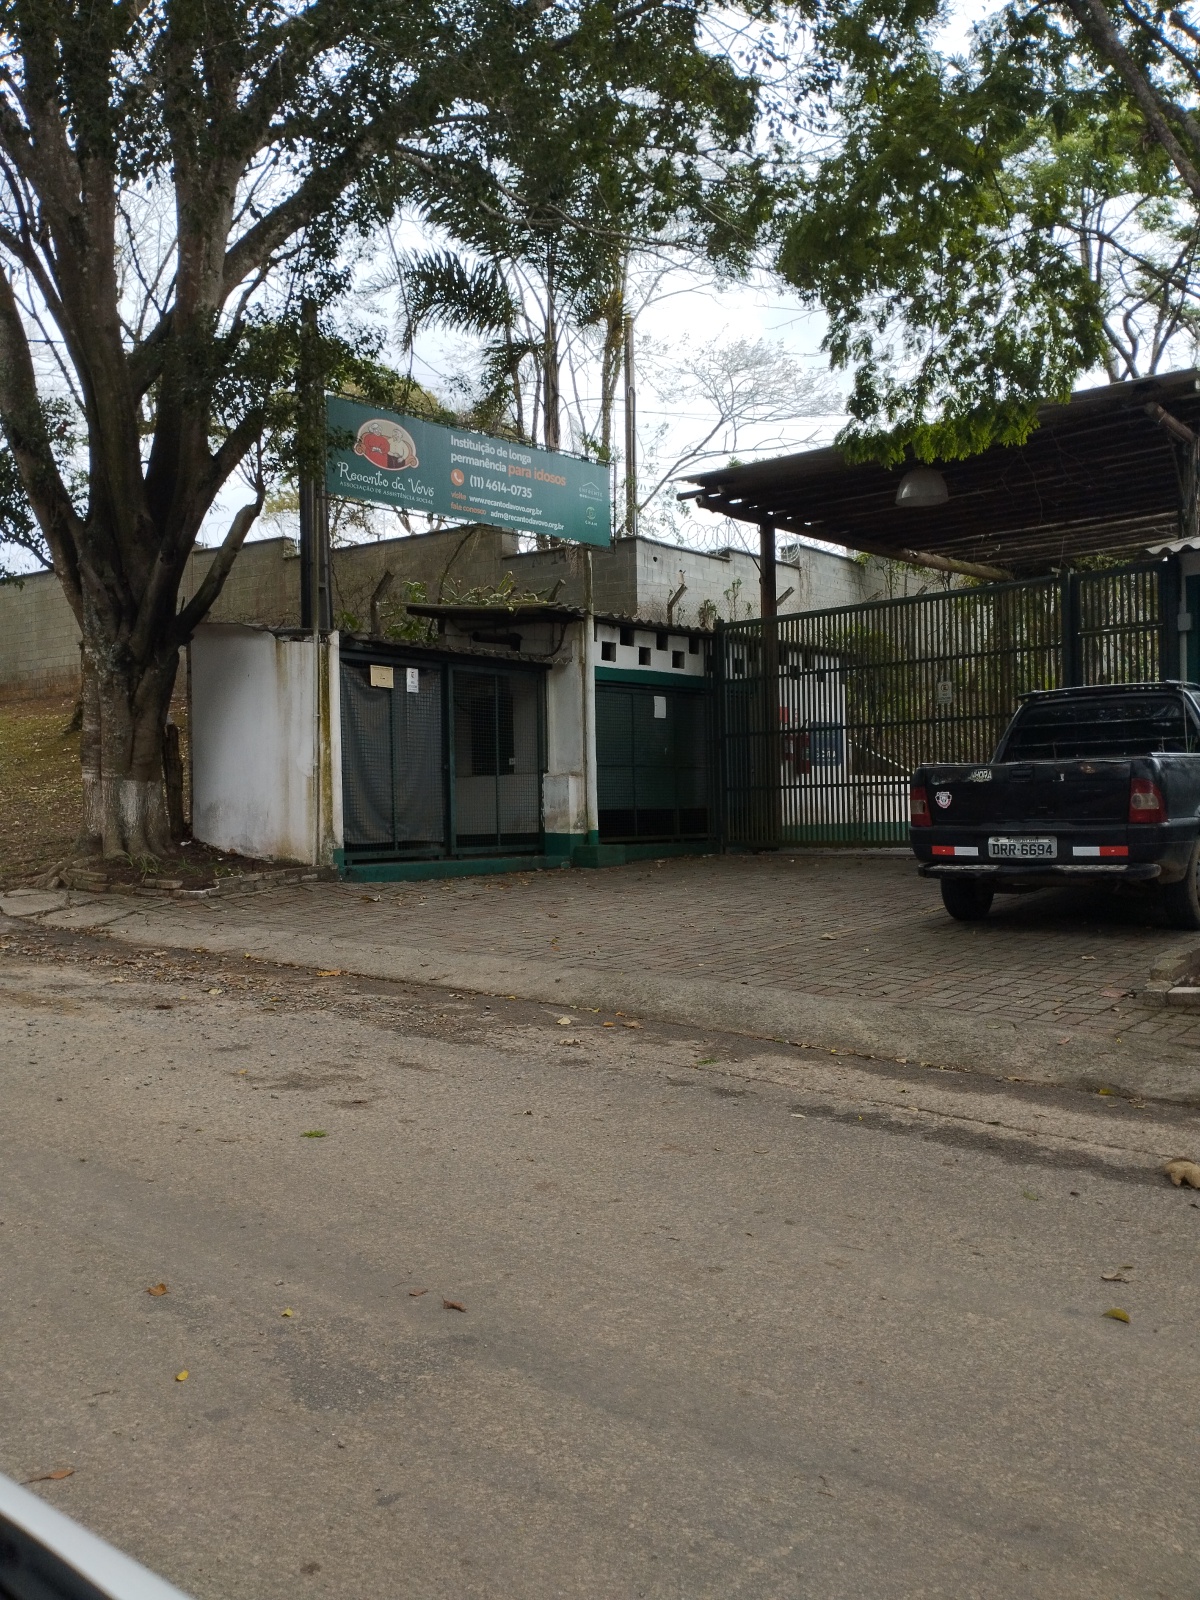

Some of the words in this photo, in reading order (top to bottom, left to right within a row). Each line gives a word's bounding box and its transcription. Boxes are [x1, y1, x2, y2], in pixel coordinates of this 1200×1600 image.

[450, 435, 495, 455] Instituição
[496, 446, 508, 458] de
[509, 449, 532, 465] longa
[337, 461, 389, 487] Recanto
[391, 476, 406, 491] da
[450, 452, 507, 473] permanência
[508, 464, 532, 478] para
[533, 467, 566, 486] idosos
[416, 496, 435, 505] SOCIAL
[469, 474, 484, 490] (11)
[485, 479, 533, 499] 4614-0735
[450, 491, 467, 500] visite
[468, 495, 543, 516] www.recantodavovo.org.br
[450, 501, 462, 511] fale
[463, 506, 487, 515] conosco
[490, 510, 565, 531] adm@recantodavovo.org.br
